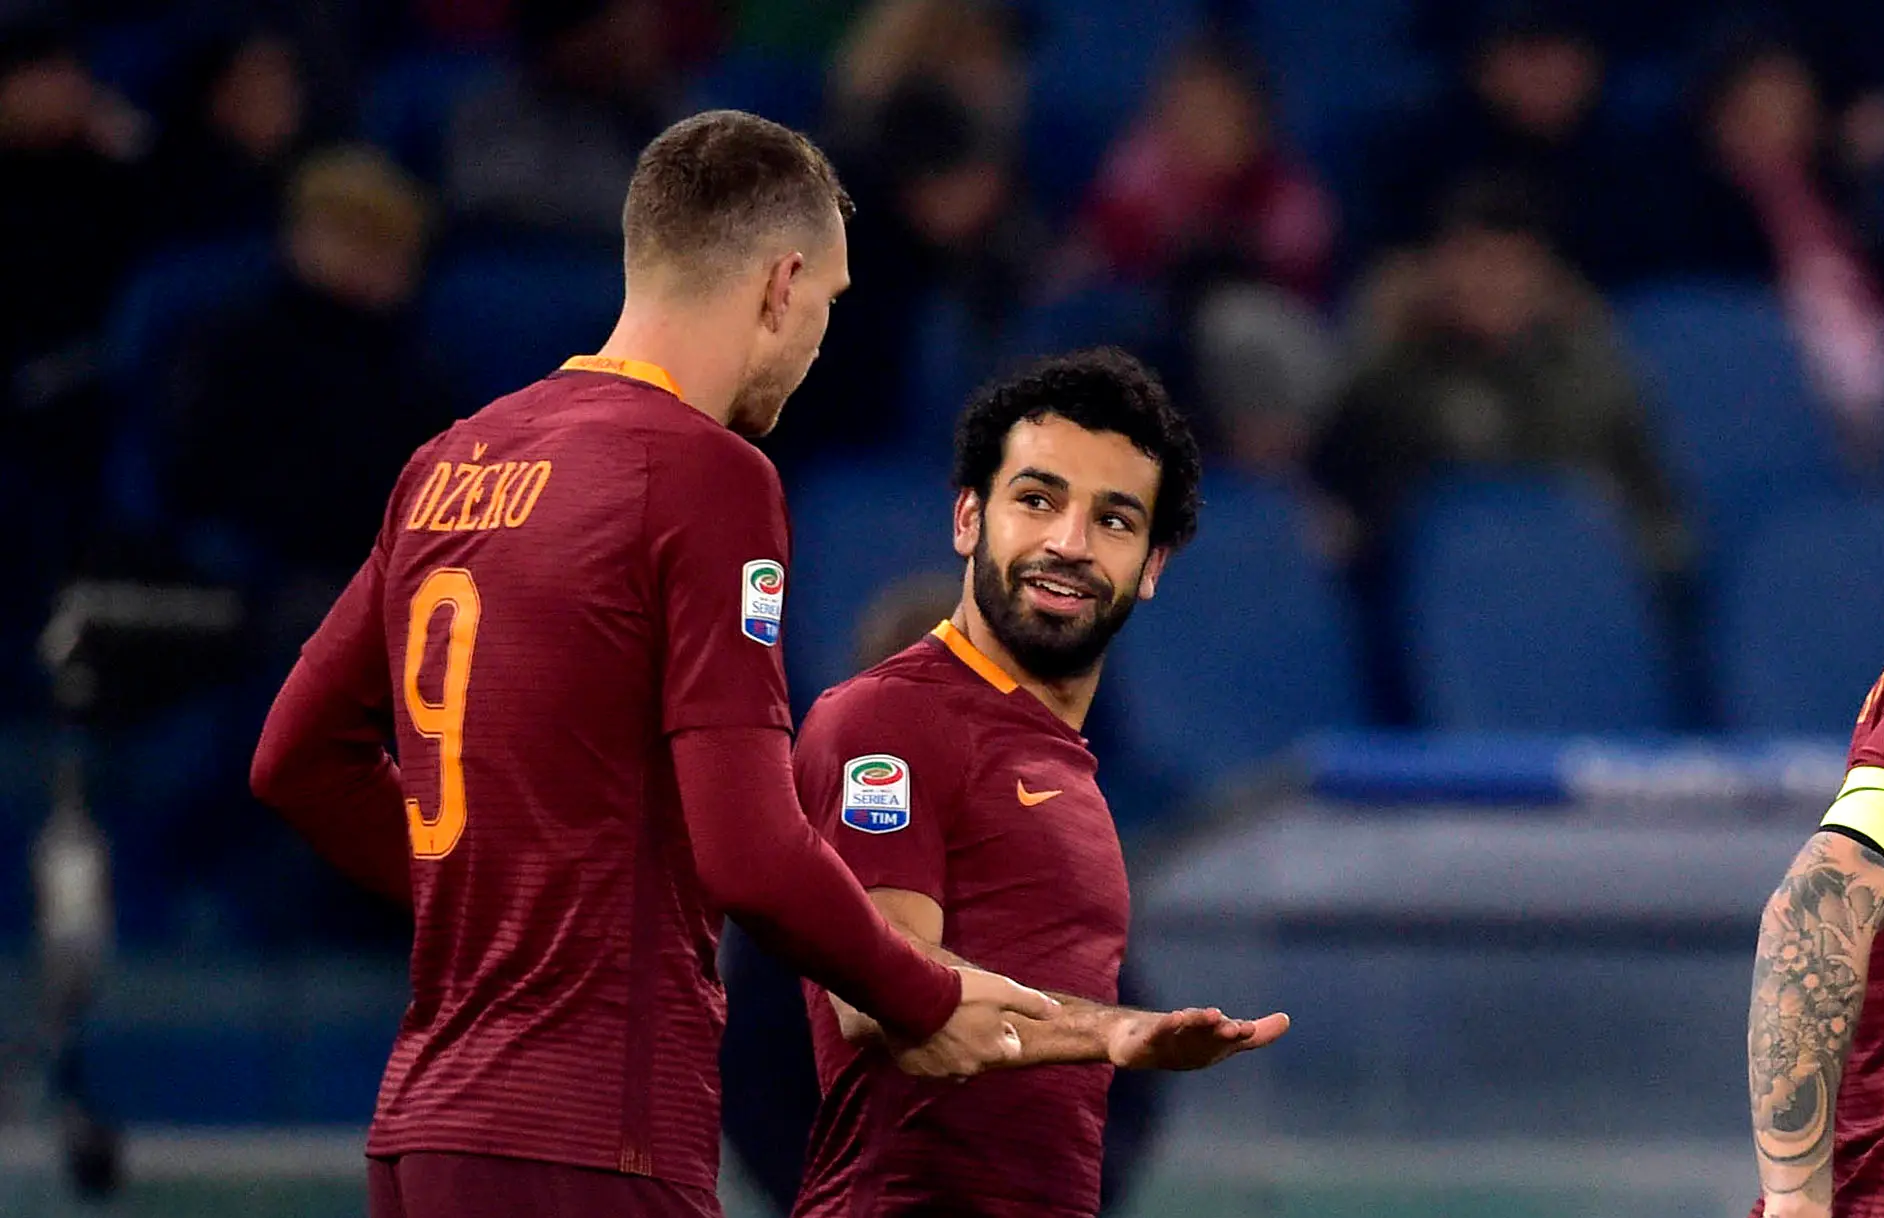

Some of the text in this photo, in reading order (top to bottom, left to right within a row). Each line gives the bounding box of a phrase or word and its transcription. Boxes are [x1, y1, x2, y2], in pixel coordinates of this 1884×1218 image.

[406, 442, 552, 531] DŽEKO
[404, 567, 480, 859] 9
[852, 793, 900, 805] SERIE A
[870, 812, 898, 826] TIM
